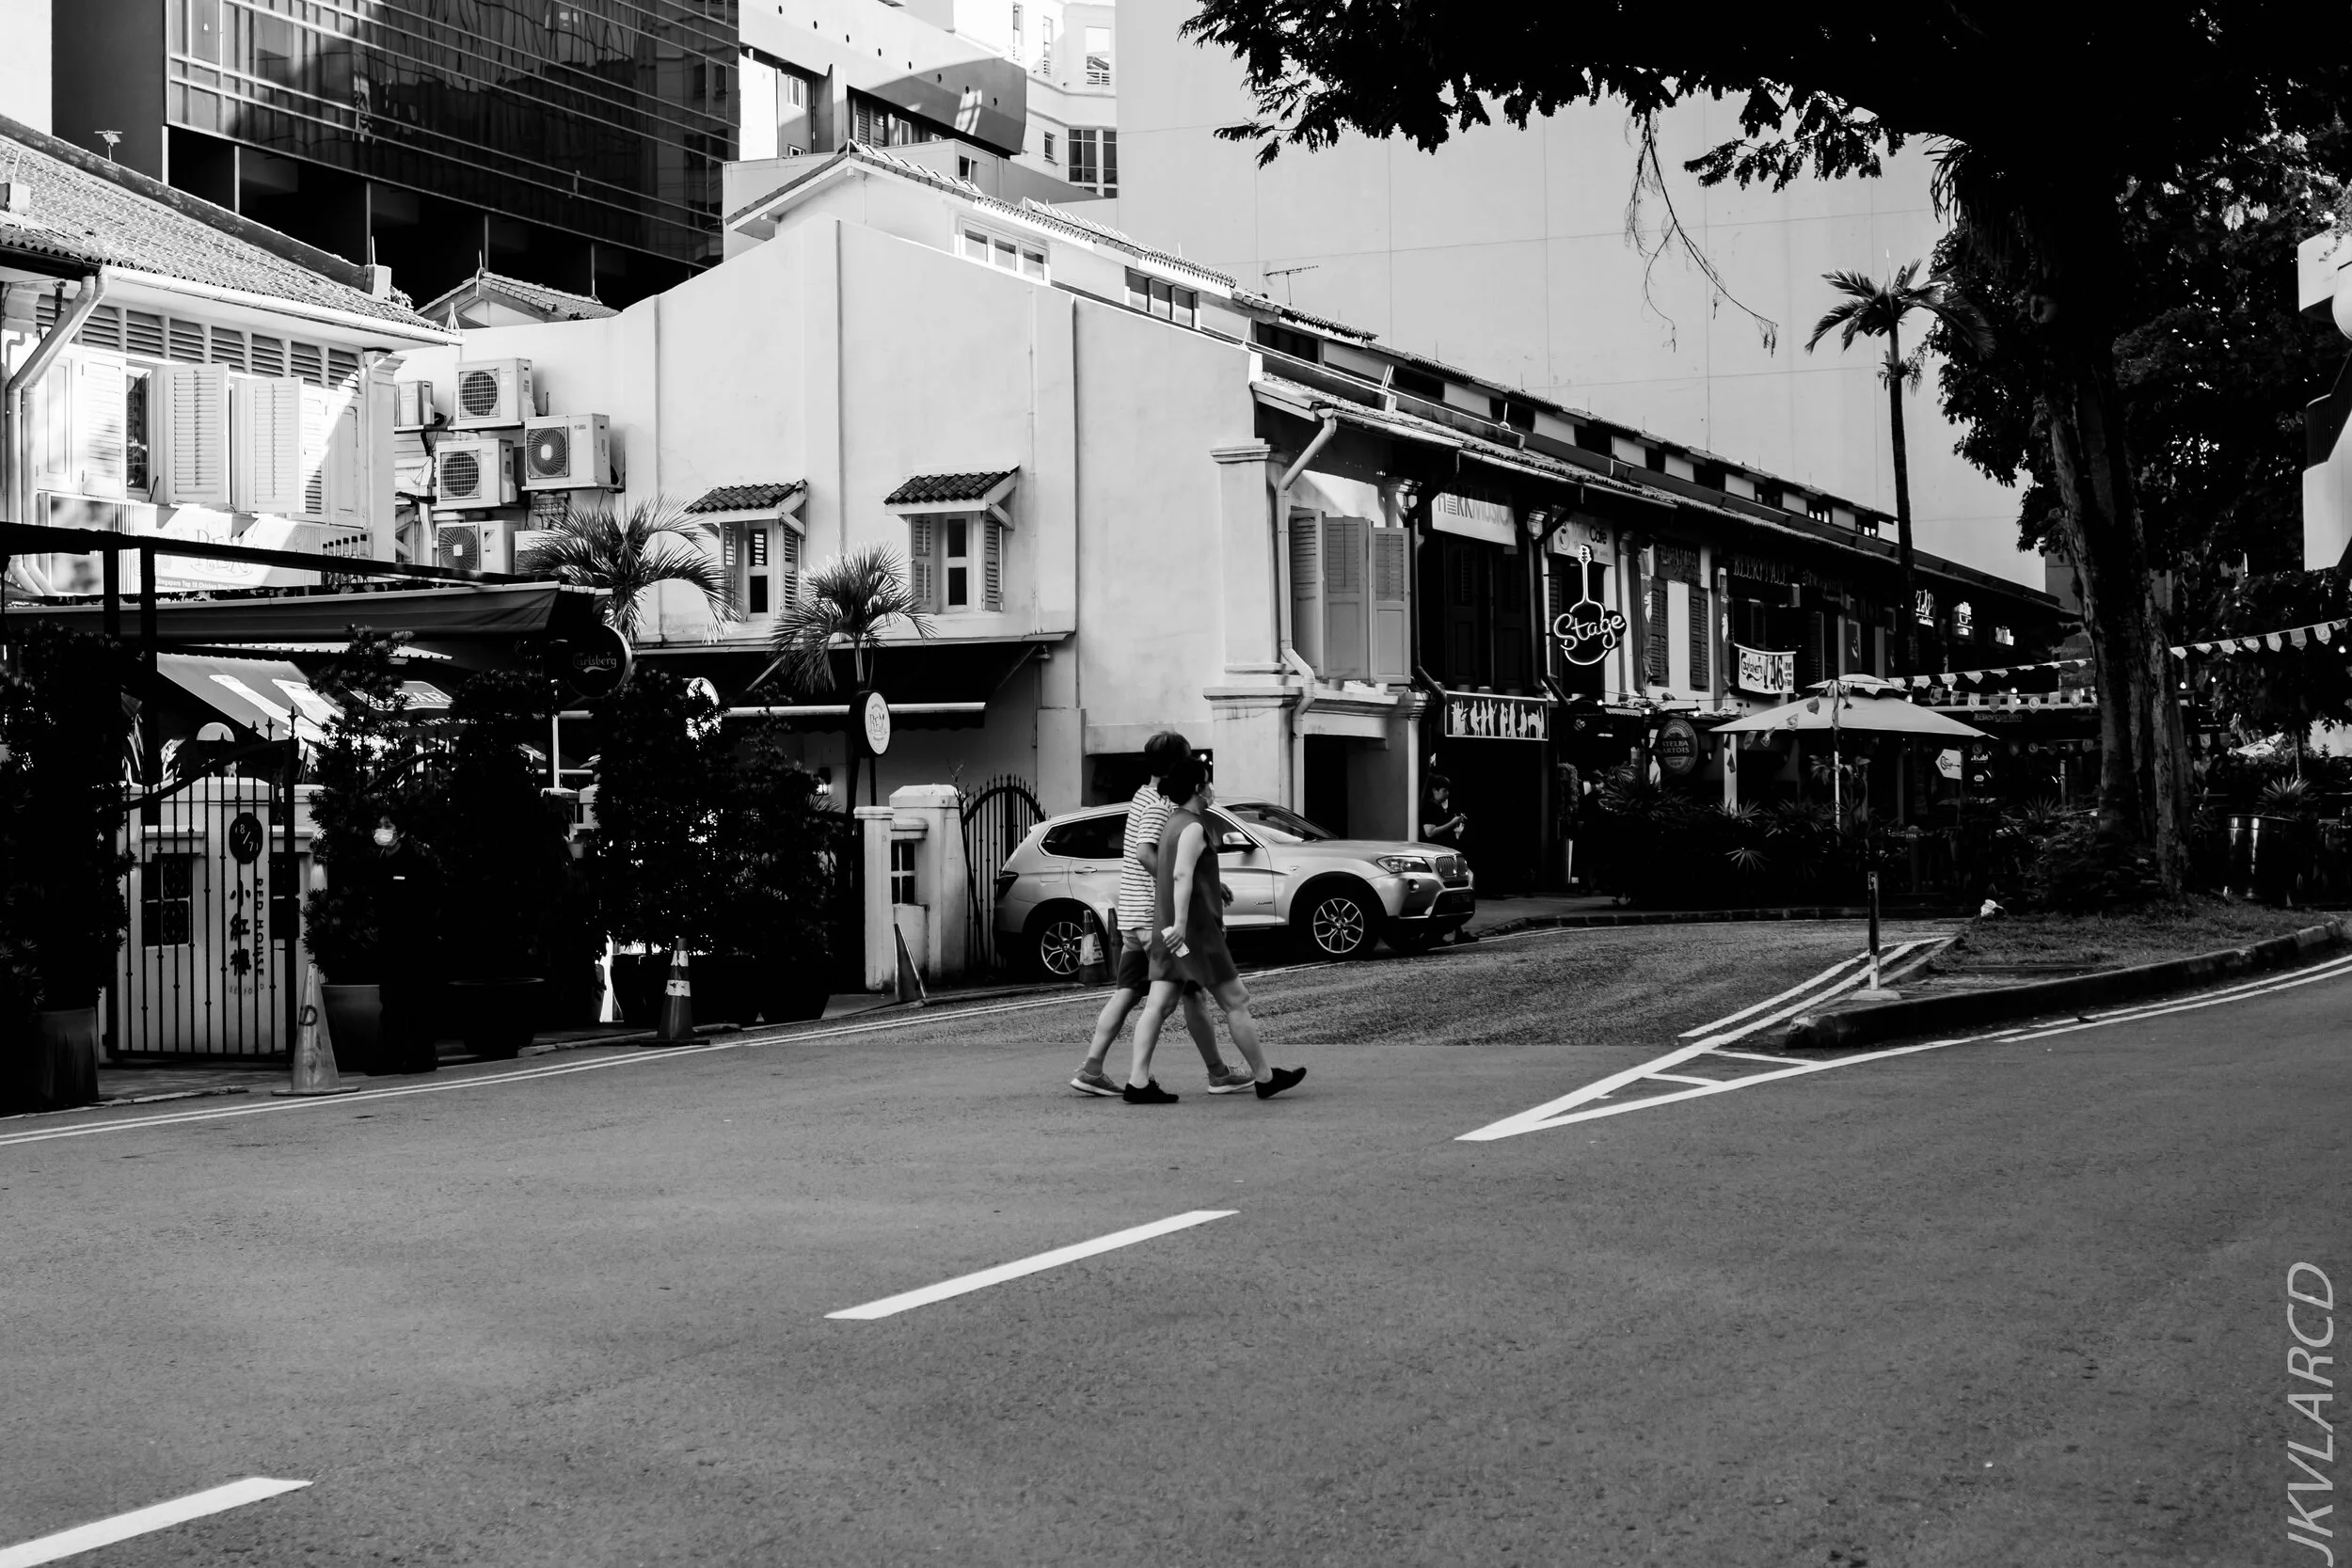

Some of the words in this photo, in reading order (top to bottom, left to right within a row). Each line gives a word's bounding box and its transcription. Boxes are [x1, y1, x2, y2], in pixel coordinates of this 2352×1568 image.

[1553, 612, 1626, 650] Stage
[572, 652, 617, 671] Carlsberg
[255, 878, 264, 911] RED
[255, 919, 264, 976] HOUSE
